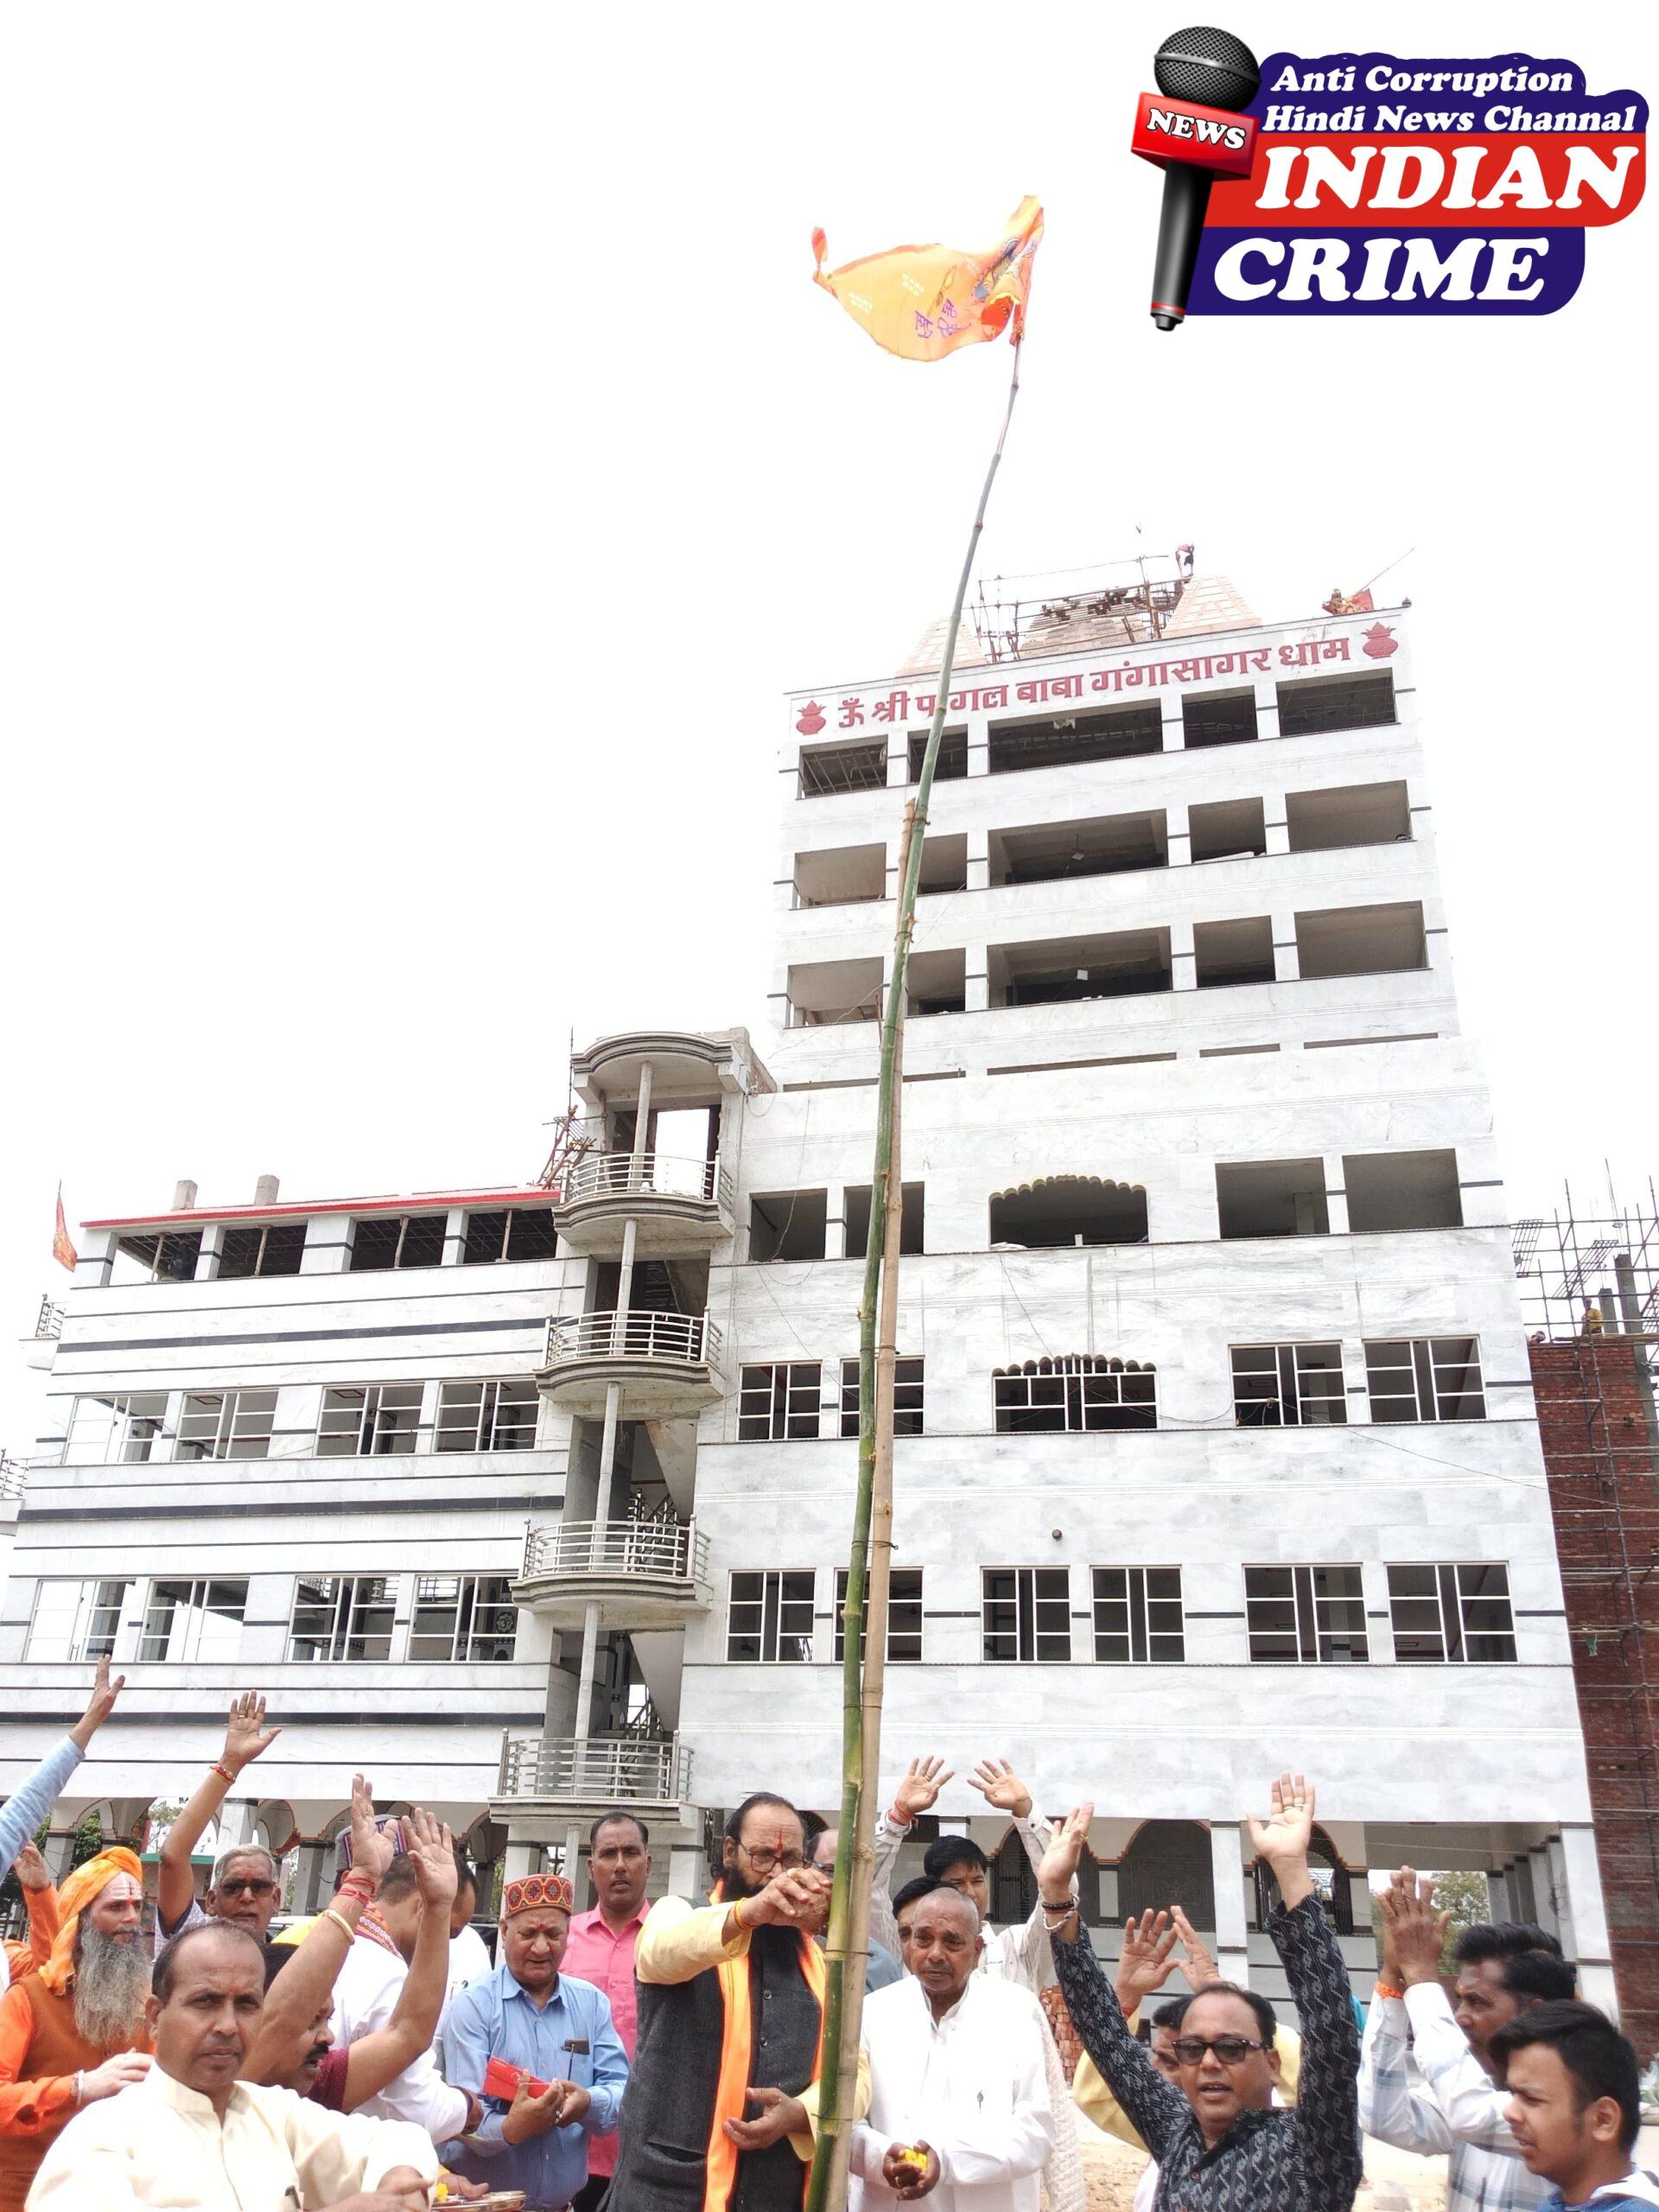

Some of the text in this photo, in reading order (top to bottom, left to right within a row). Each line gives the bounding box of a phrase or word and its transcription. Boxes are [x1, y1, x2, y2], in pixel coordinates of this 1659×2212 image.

[871, 690, 911, 722] श्री
[915, 685, 1009, 717] पगल
[1016, 674, 1084, 702] बाबा
[1279, 638, 1351, 666] धाम
